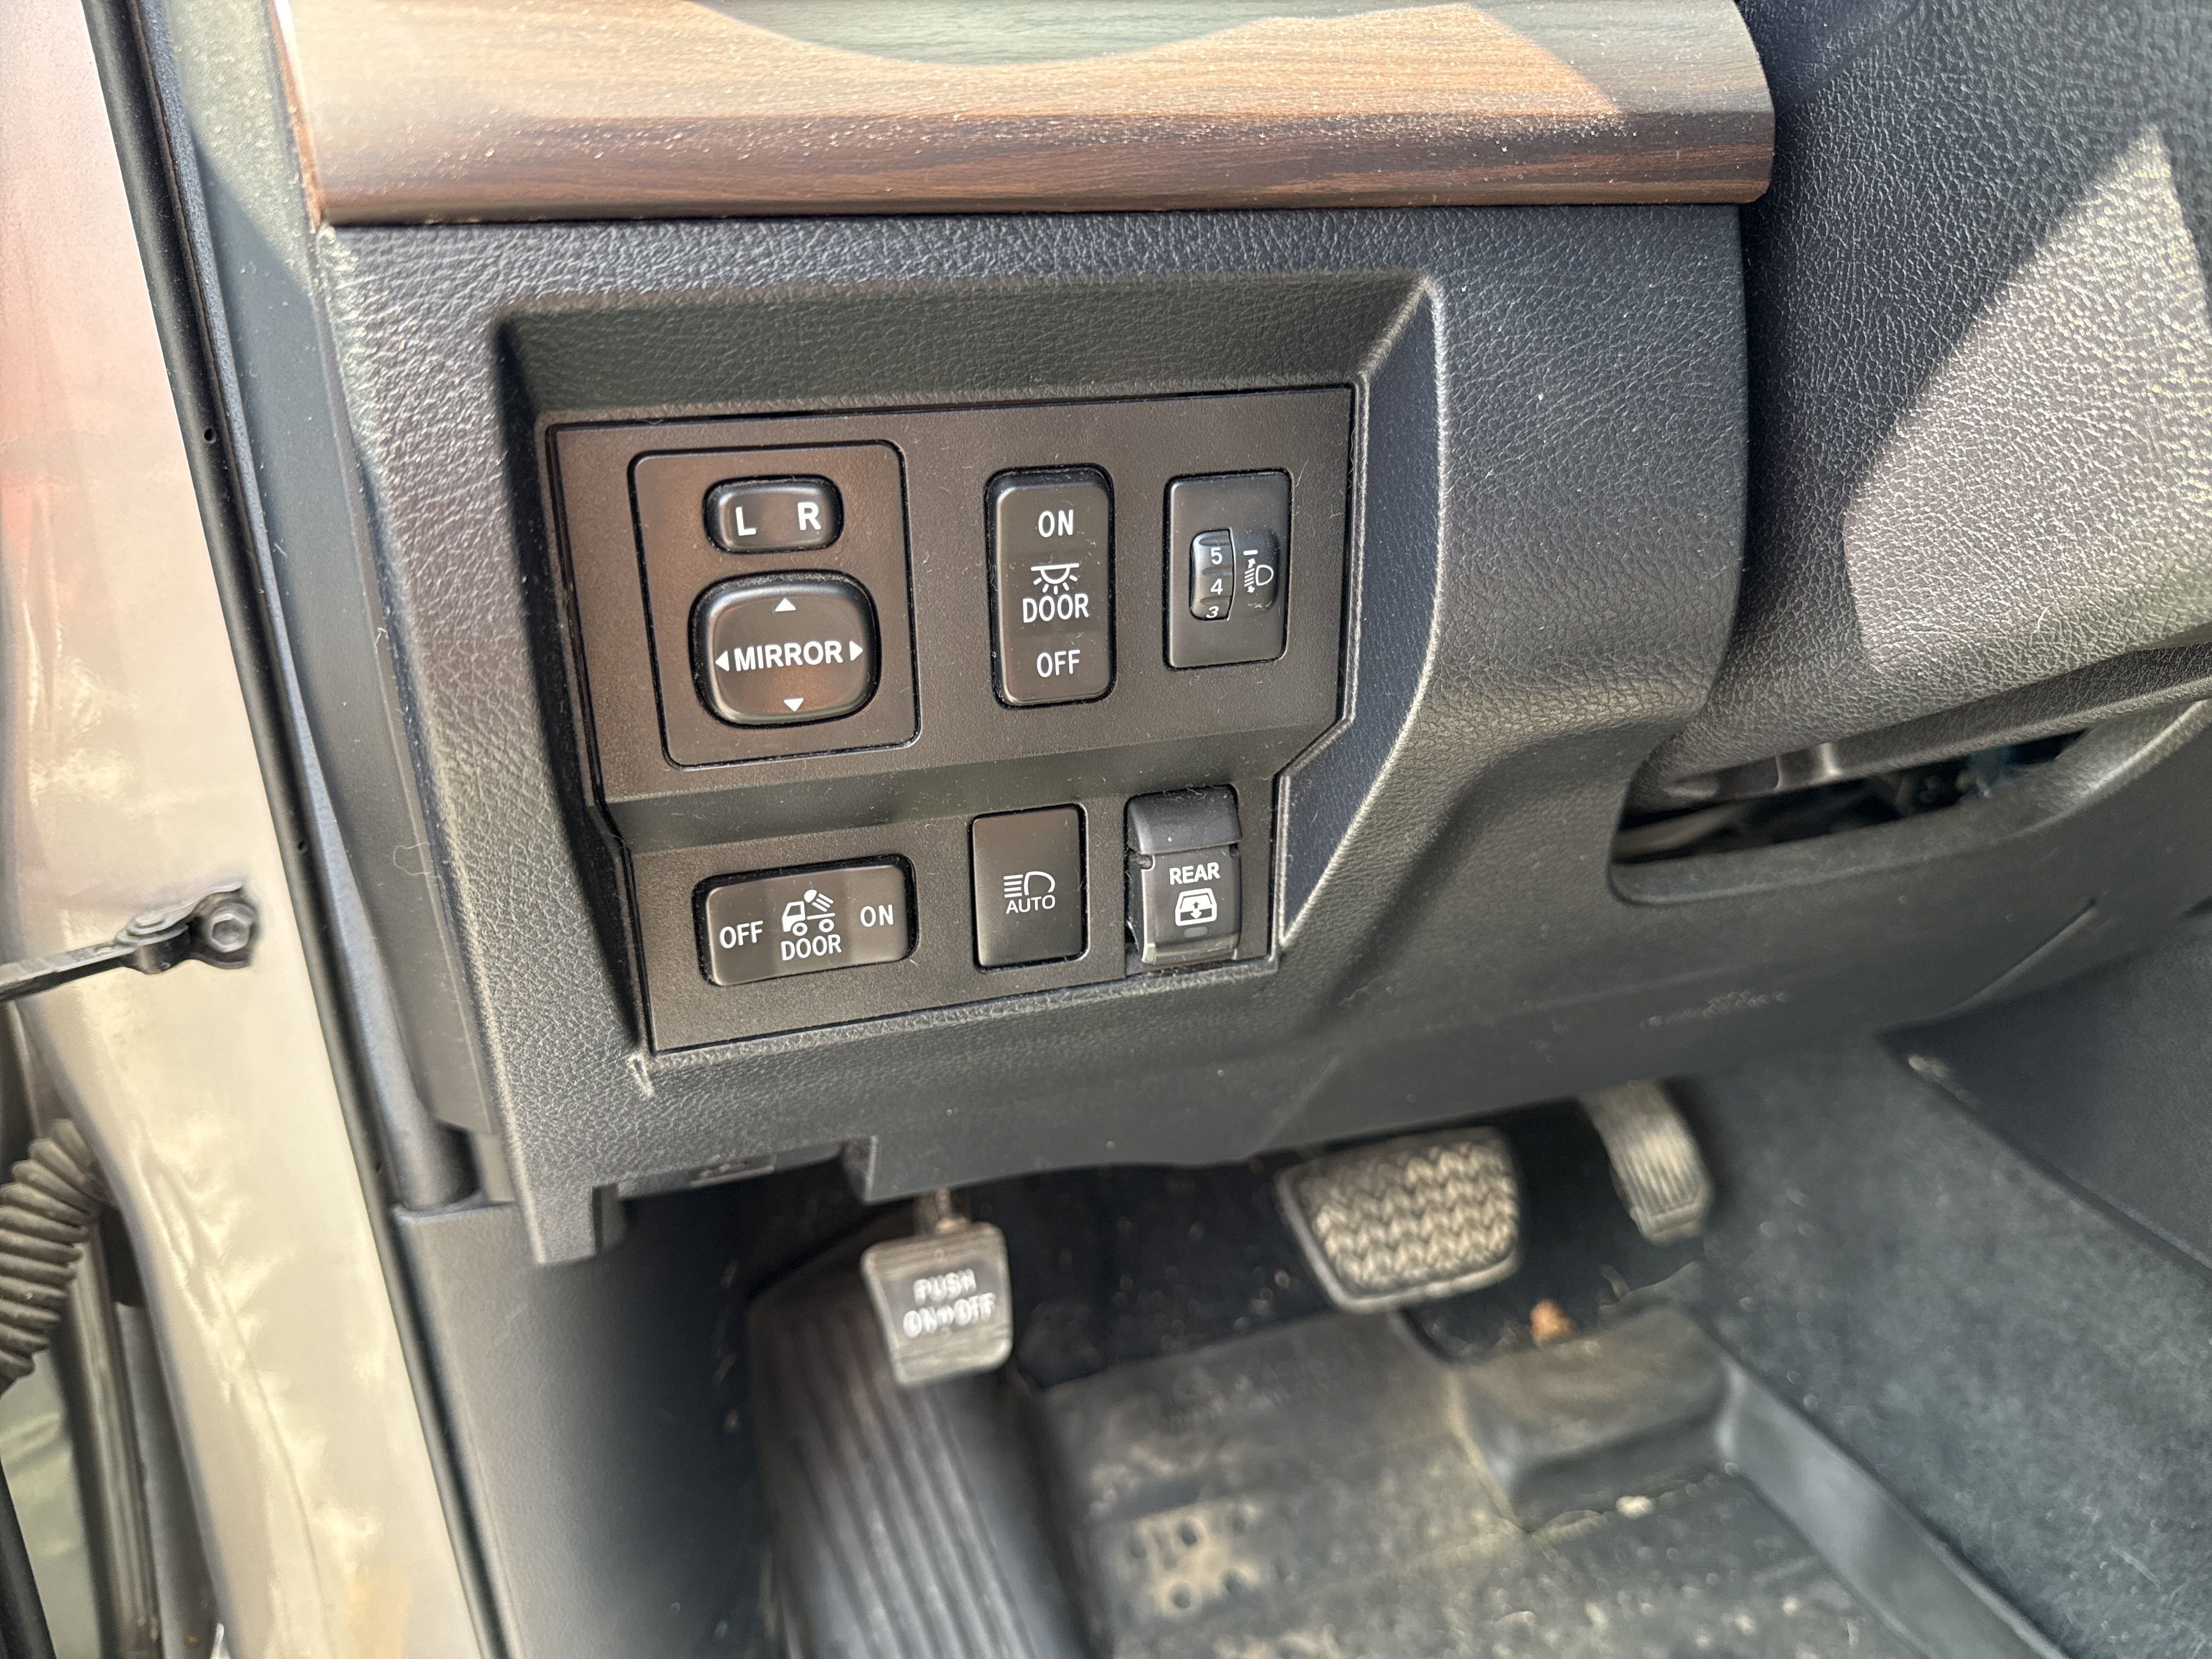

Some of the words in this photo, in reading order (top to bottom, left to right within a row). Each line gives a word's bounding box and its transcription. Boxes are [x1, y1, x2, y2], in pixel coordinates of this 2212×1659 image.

[735, 506, 757, 536] L
[797, 501, 821, 531] R
[1038, 509, 1074, 538] ON
[1210, 547, 1223, 565] 5
[1210, 578, 1223, 595] 4
[1022, 593, 1089, 623] DOOR
[1205, 606, 1219, 619] 3
[733, 640, 844, 672] MIRROR
[1036, 650, 1081, 678] OFF
[1169, 862, 1221, 885] REAR
[860, 904, 894, 927] ON
[1006, 894, 1056, 915] AUTO
[719, 921, 764, 949] OFF
[781, 934, 842, 961] DOOR
[913, 1268, 977, 1306] PUSH
